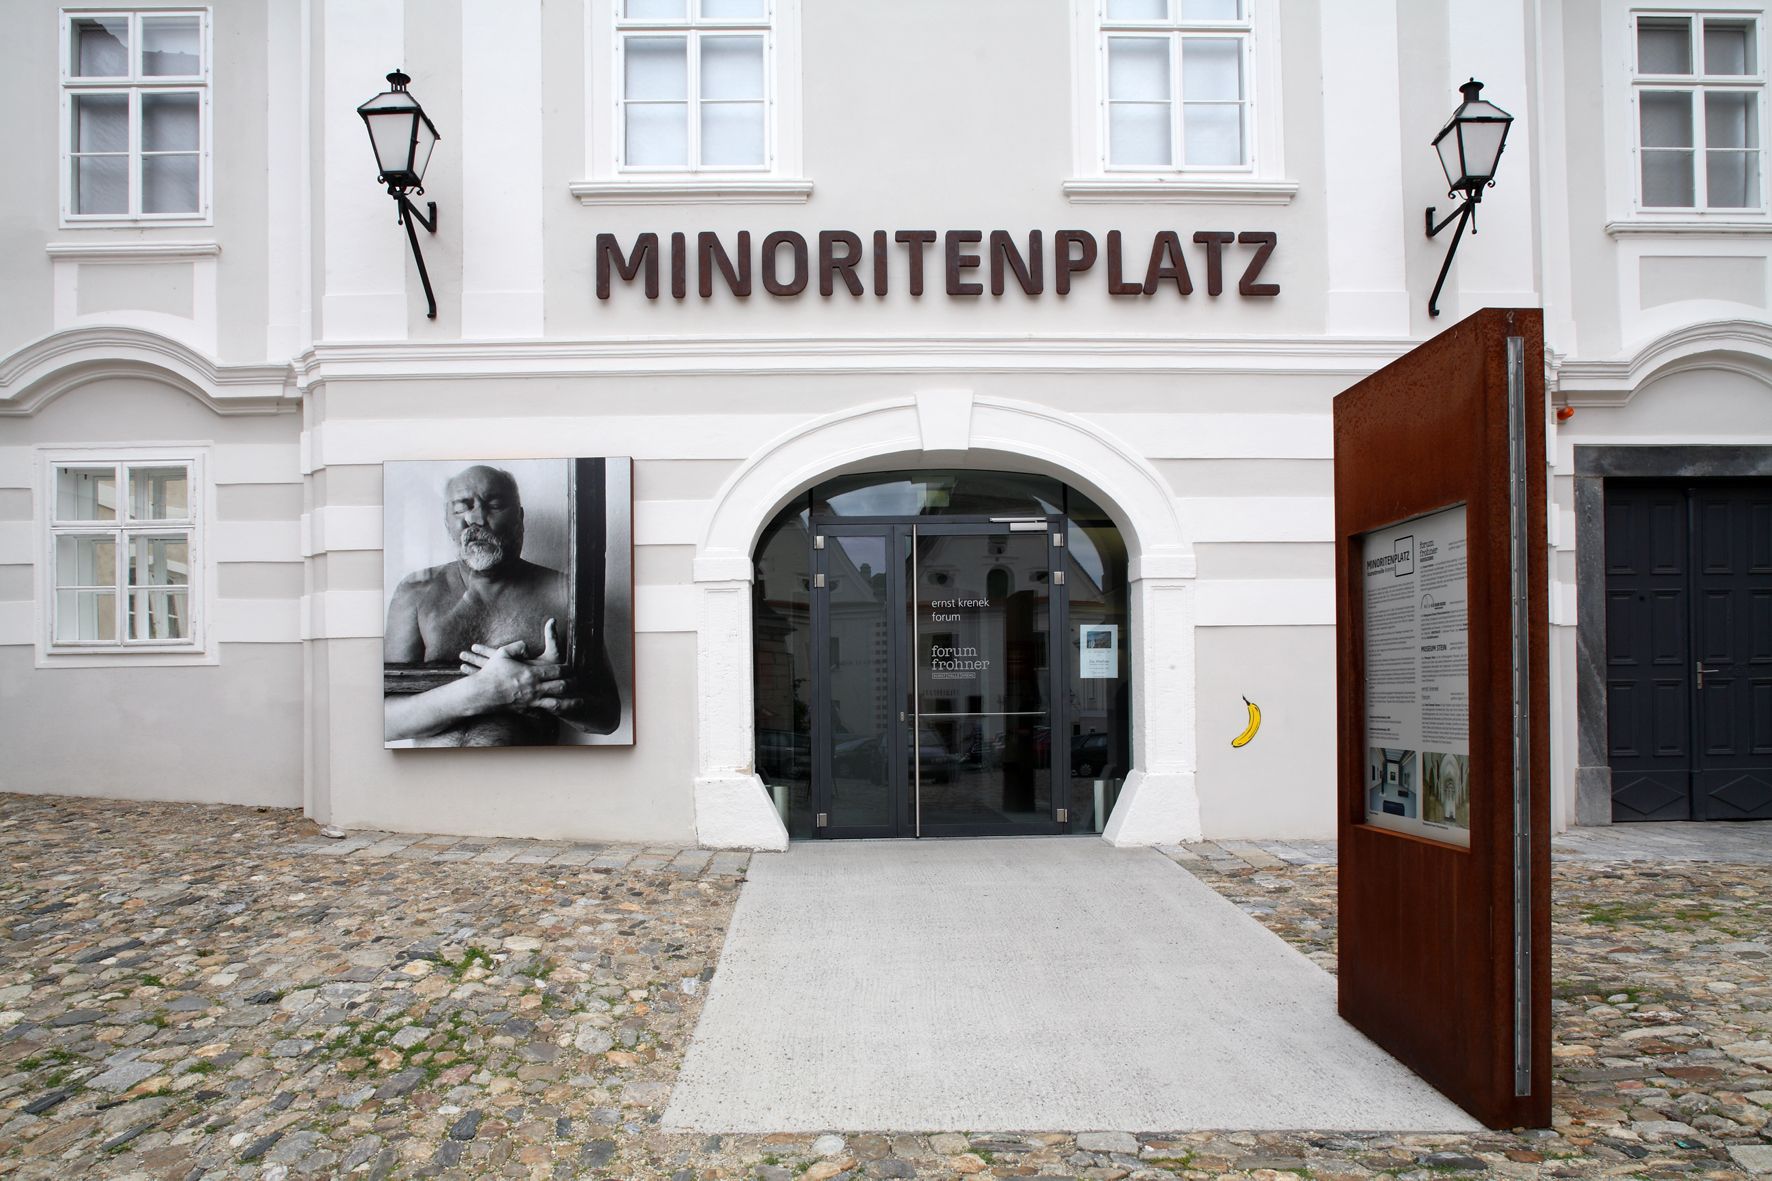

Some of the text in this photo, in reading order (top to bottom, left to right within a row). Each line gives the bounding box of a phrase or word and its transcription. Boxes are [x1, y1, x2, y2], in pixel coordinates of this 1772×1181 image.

[596, 229, 1281, 300] MINORITENPLATZ
[1366, 550, 1410, 570] MINORITENPLATZ
[931, 596, 990, 608] ernst krenek
[931, 611, 961, 622] forum
[931, 644, 978, 658] forum
[931, 657, 990, 671] frohner
